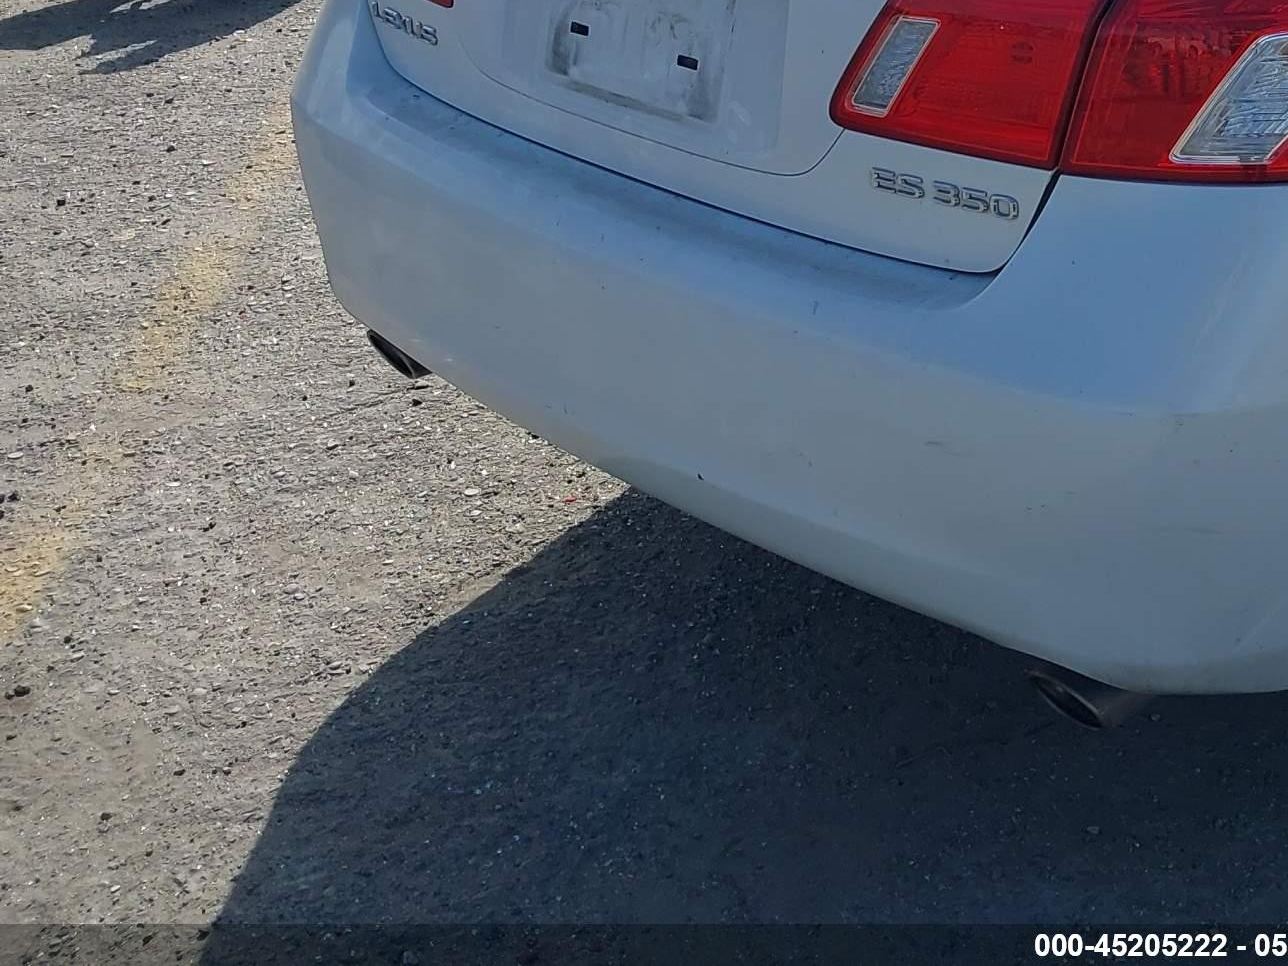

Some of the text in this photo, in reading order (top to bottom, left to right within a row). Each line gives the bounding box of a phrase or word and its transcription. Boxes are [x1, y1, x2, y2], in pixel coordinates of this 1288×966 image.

[371, 0, 439, 47] LEXUS
[871, 166, 1020, 220] ES 350
